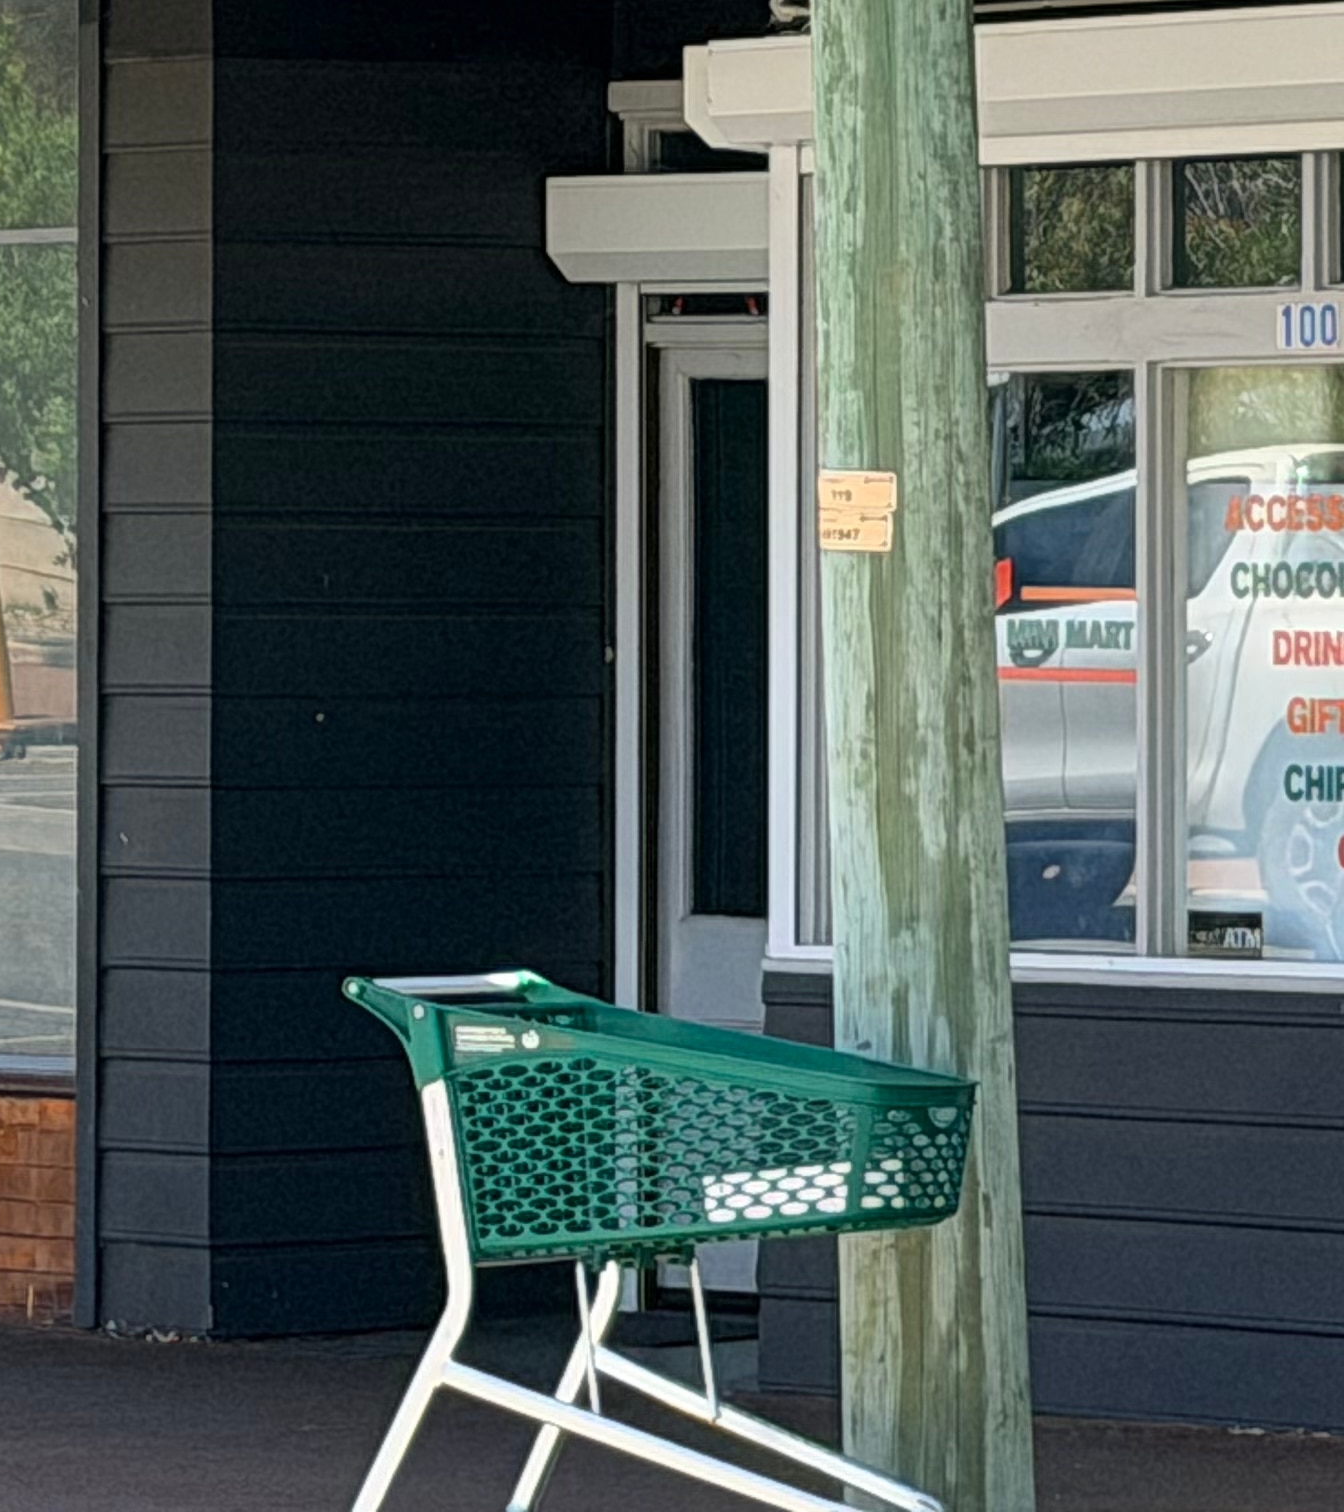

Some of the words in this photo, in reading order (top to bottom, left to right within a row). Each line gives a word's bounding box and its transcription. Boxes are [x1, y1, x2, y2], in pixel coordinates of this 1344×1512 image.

[1282, 304, 1338, 348] 100
[1006, 619, 1059, 649] MINI
[1065, 620, 1135, 650] MART
[1222, 928, 1261, 949] ATM
